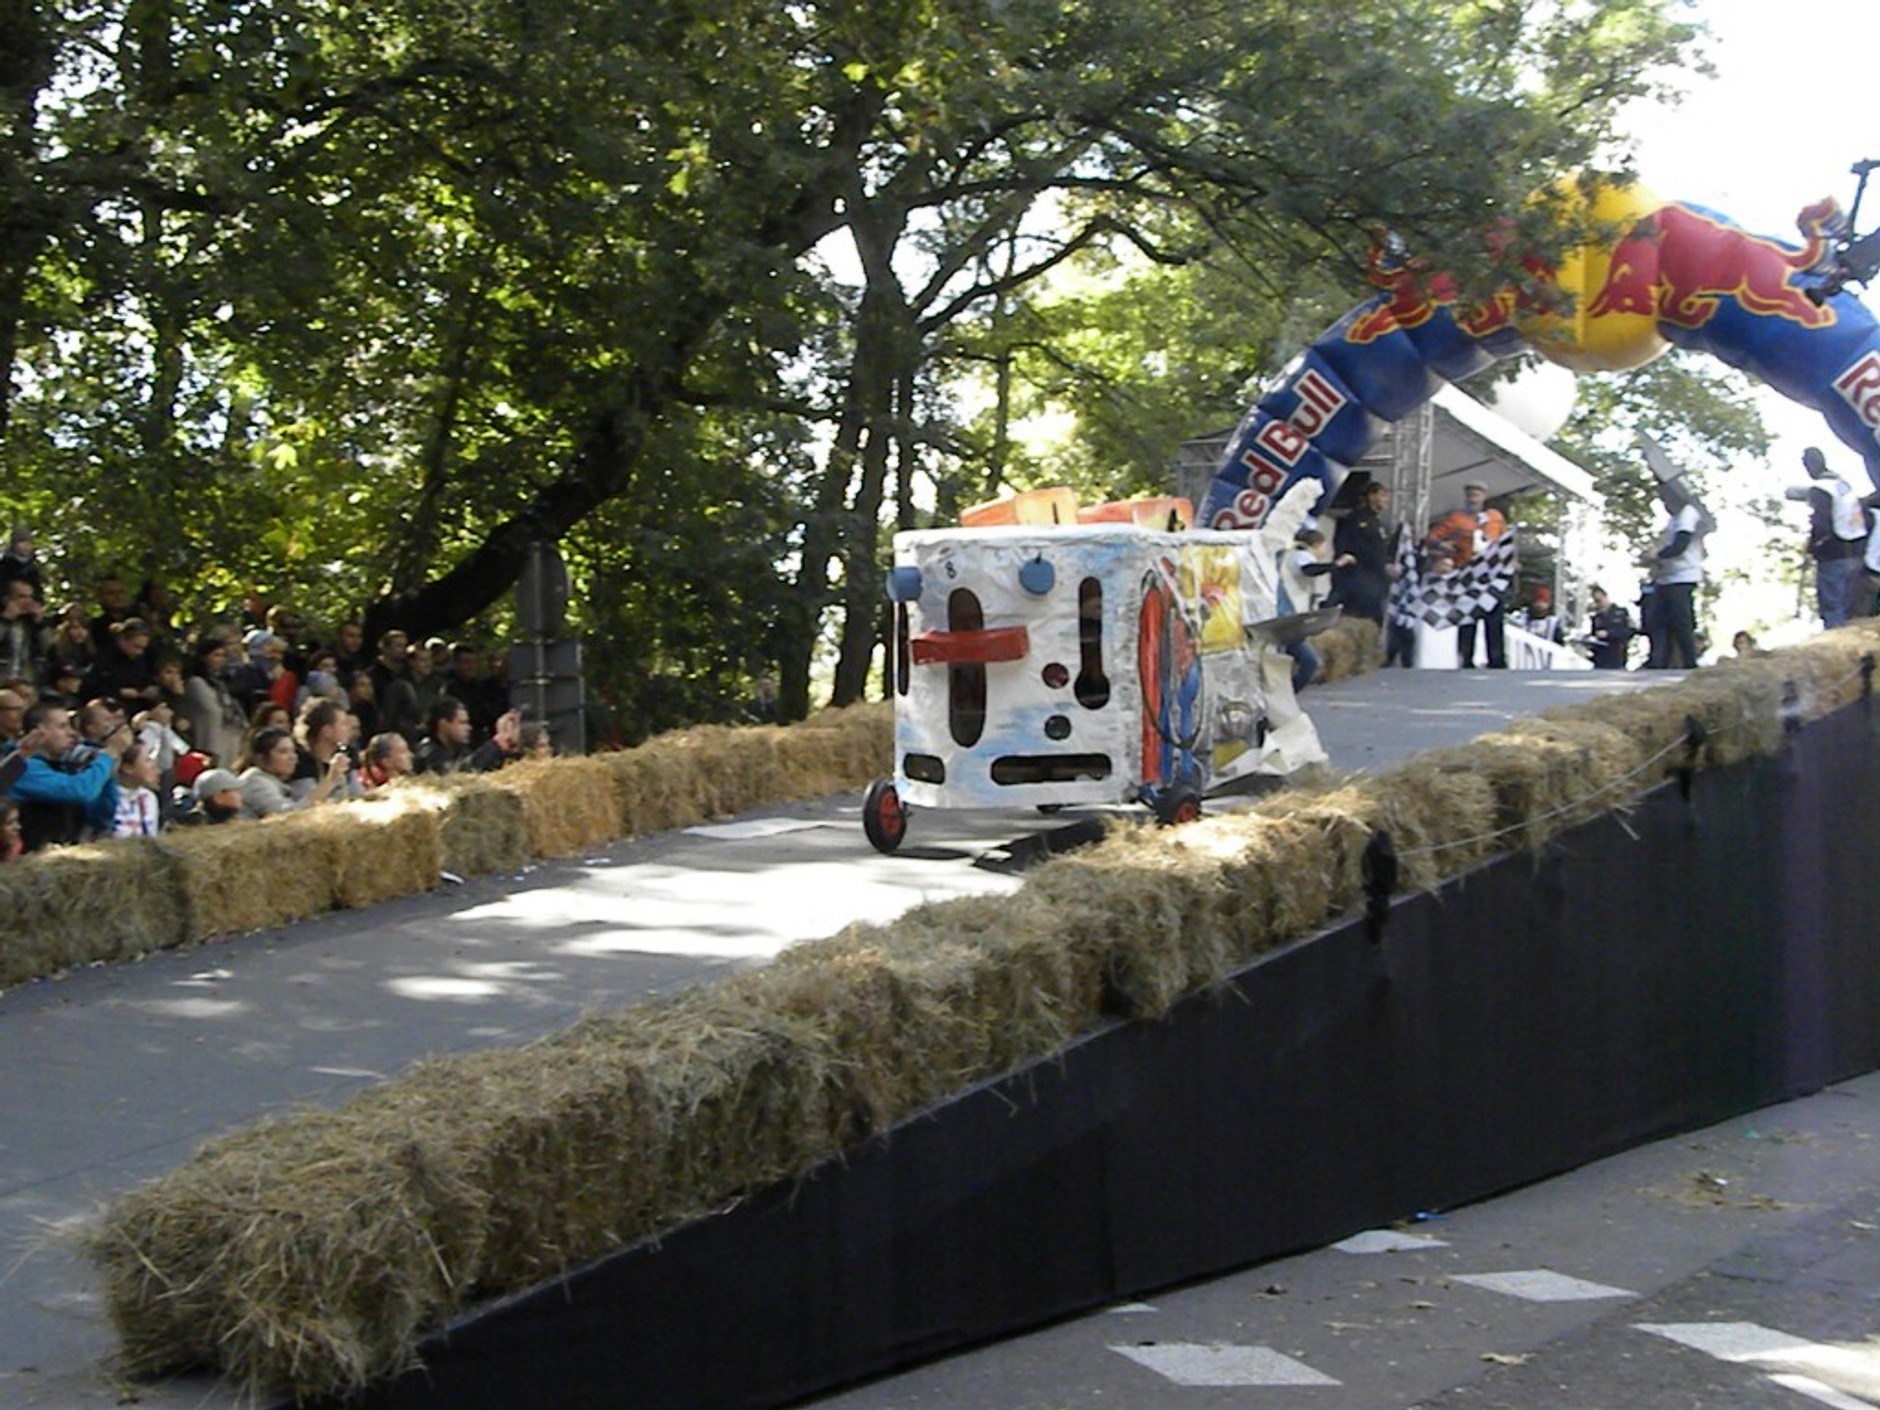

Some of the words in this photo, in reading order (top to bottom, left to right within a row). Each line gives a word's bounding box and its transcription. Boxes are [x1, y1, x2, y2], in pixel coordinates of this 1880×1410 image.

[1212, 450, 1288, 530] Red
[1256, 369, 1346, 467] Bull
[1832, 350, 1880, 430] Re
